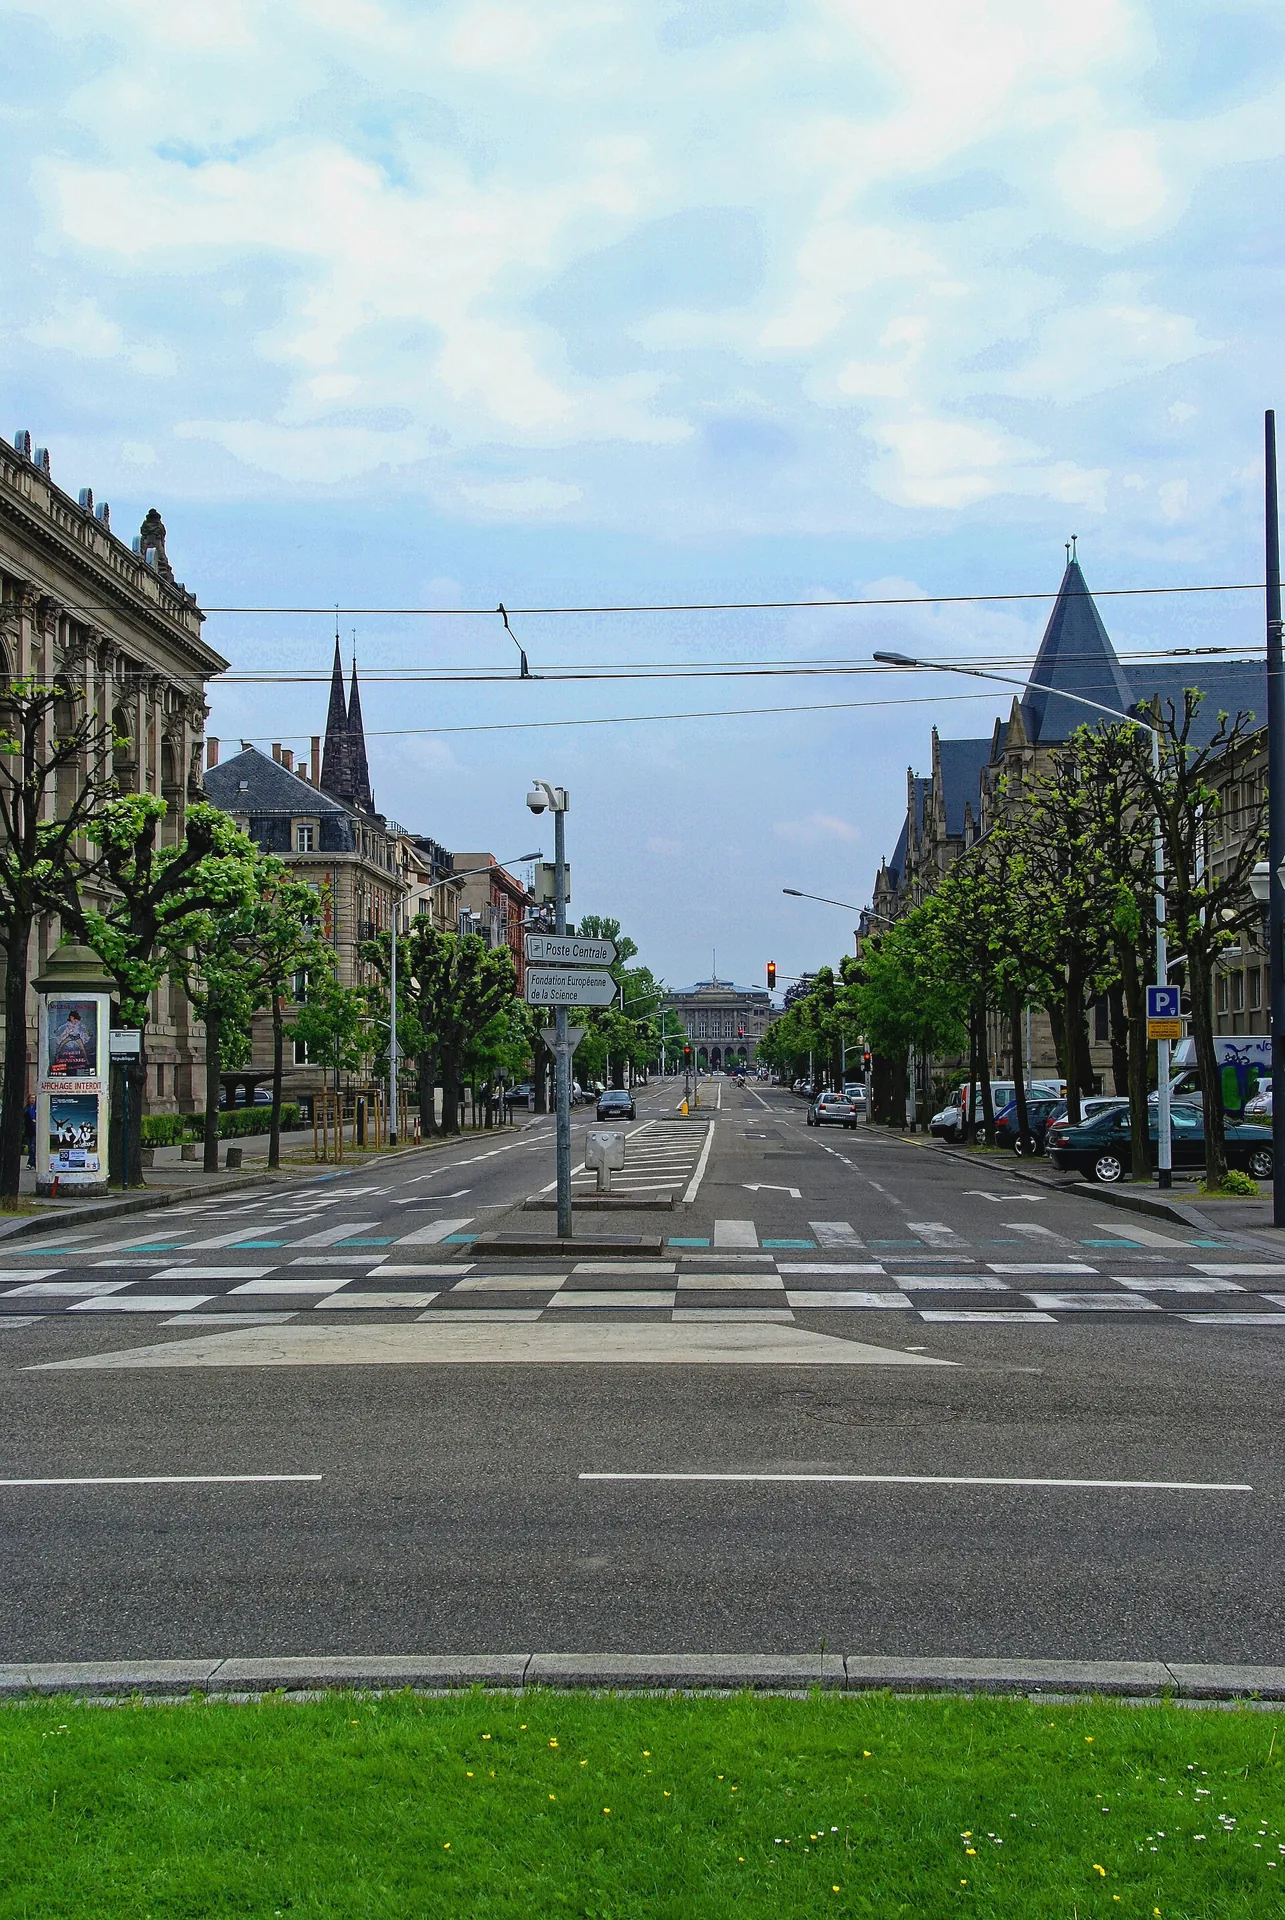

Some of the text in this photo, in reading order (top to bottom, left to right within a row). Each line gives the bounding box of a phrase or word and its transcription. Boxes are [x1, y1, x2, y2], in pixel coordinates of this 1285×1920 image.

[546, 942, 607, 959] Poste Centrale
[531, 974, 606, 988] Fondation Européenne
[531, 989, 578, 1000] de la Science
[1156, 993, 1170, 1012] P
[41, 1082, 102, 1090] AFFICHAGE INTERDIT
